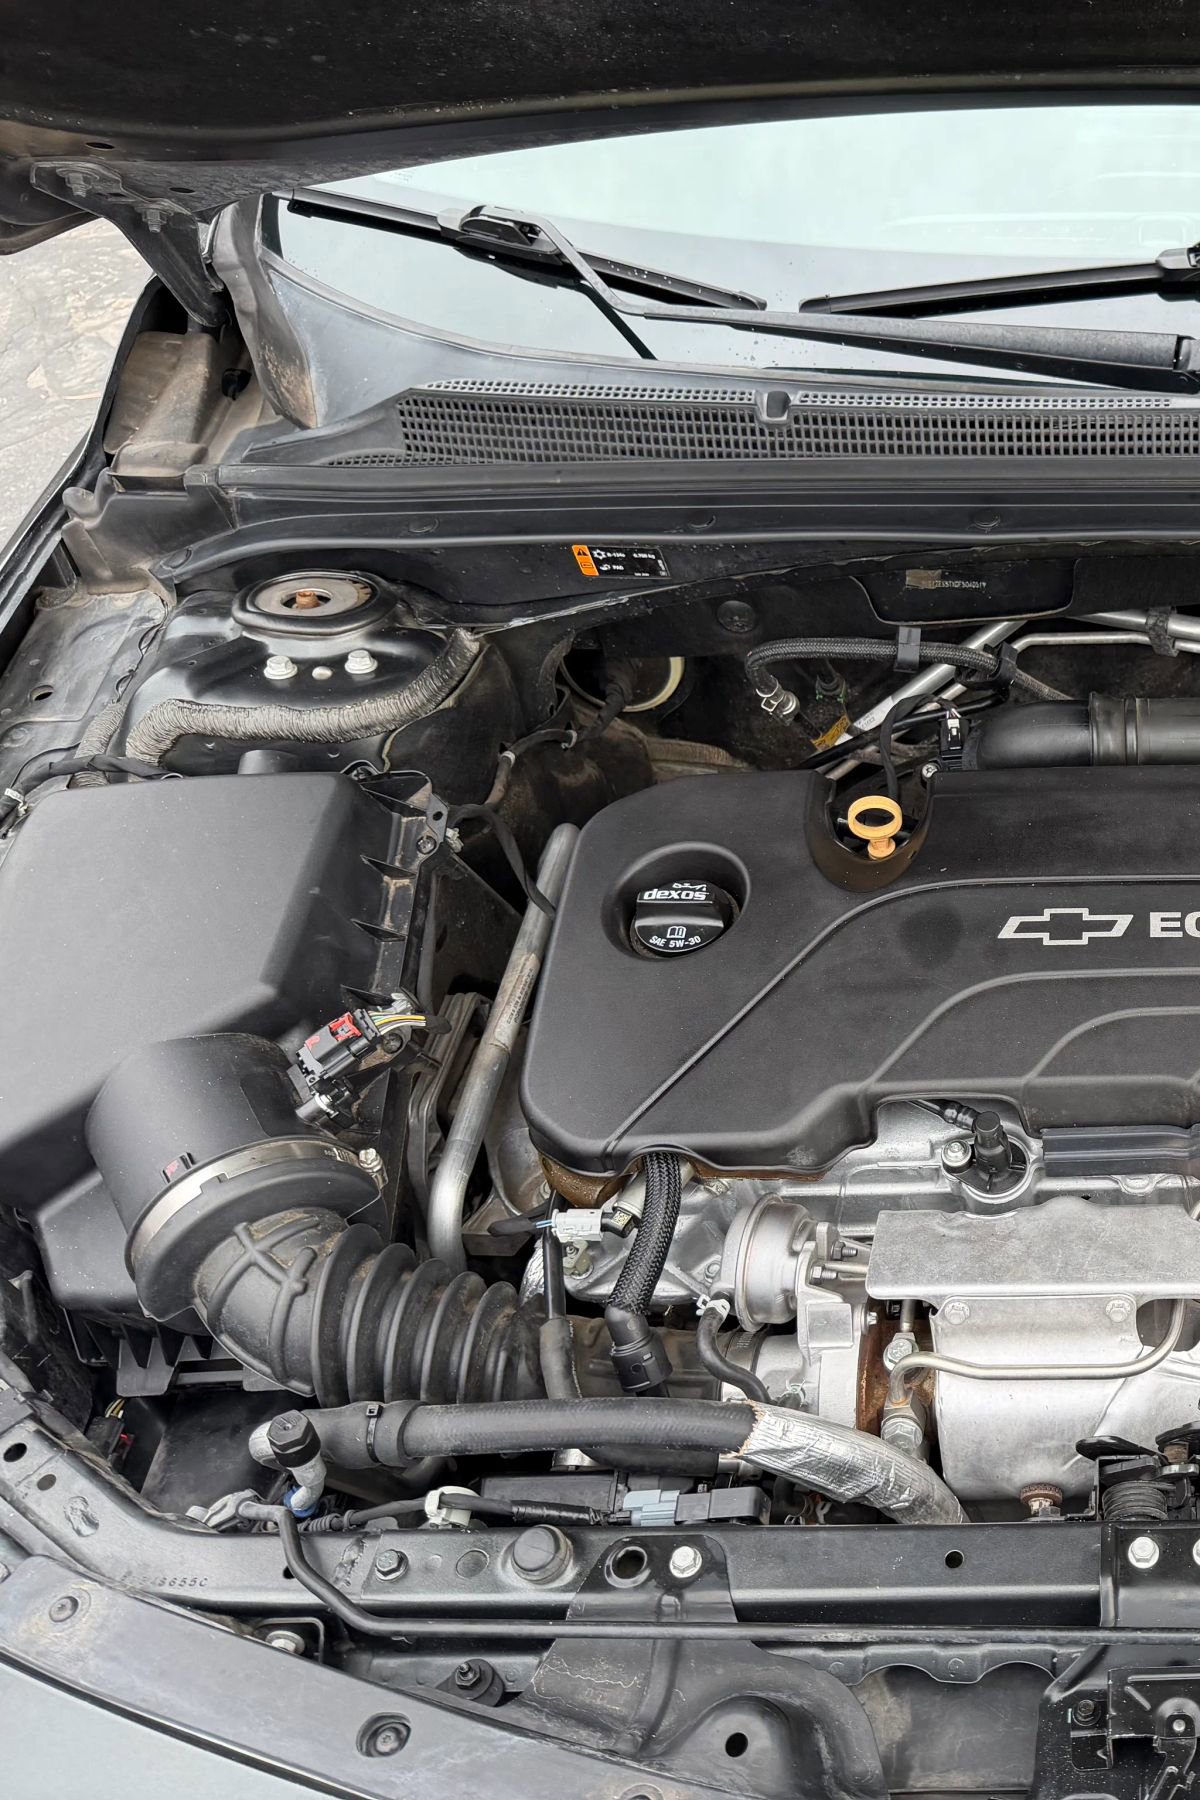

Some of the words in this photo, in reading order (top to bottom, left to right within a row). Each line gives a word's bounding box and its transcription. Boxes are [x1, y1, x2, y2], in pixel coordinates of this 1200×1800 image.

[643, 888, 709, 901] dexos
[649, 935, 667, 947] SAE
[669, 935, 701, 948] 5W-30
